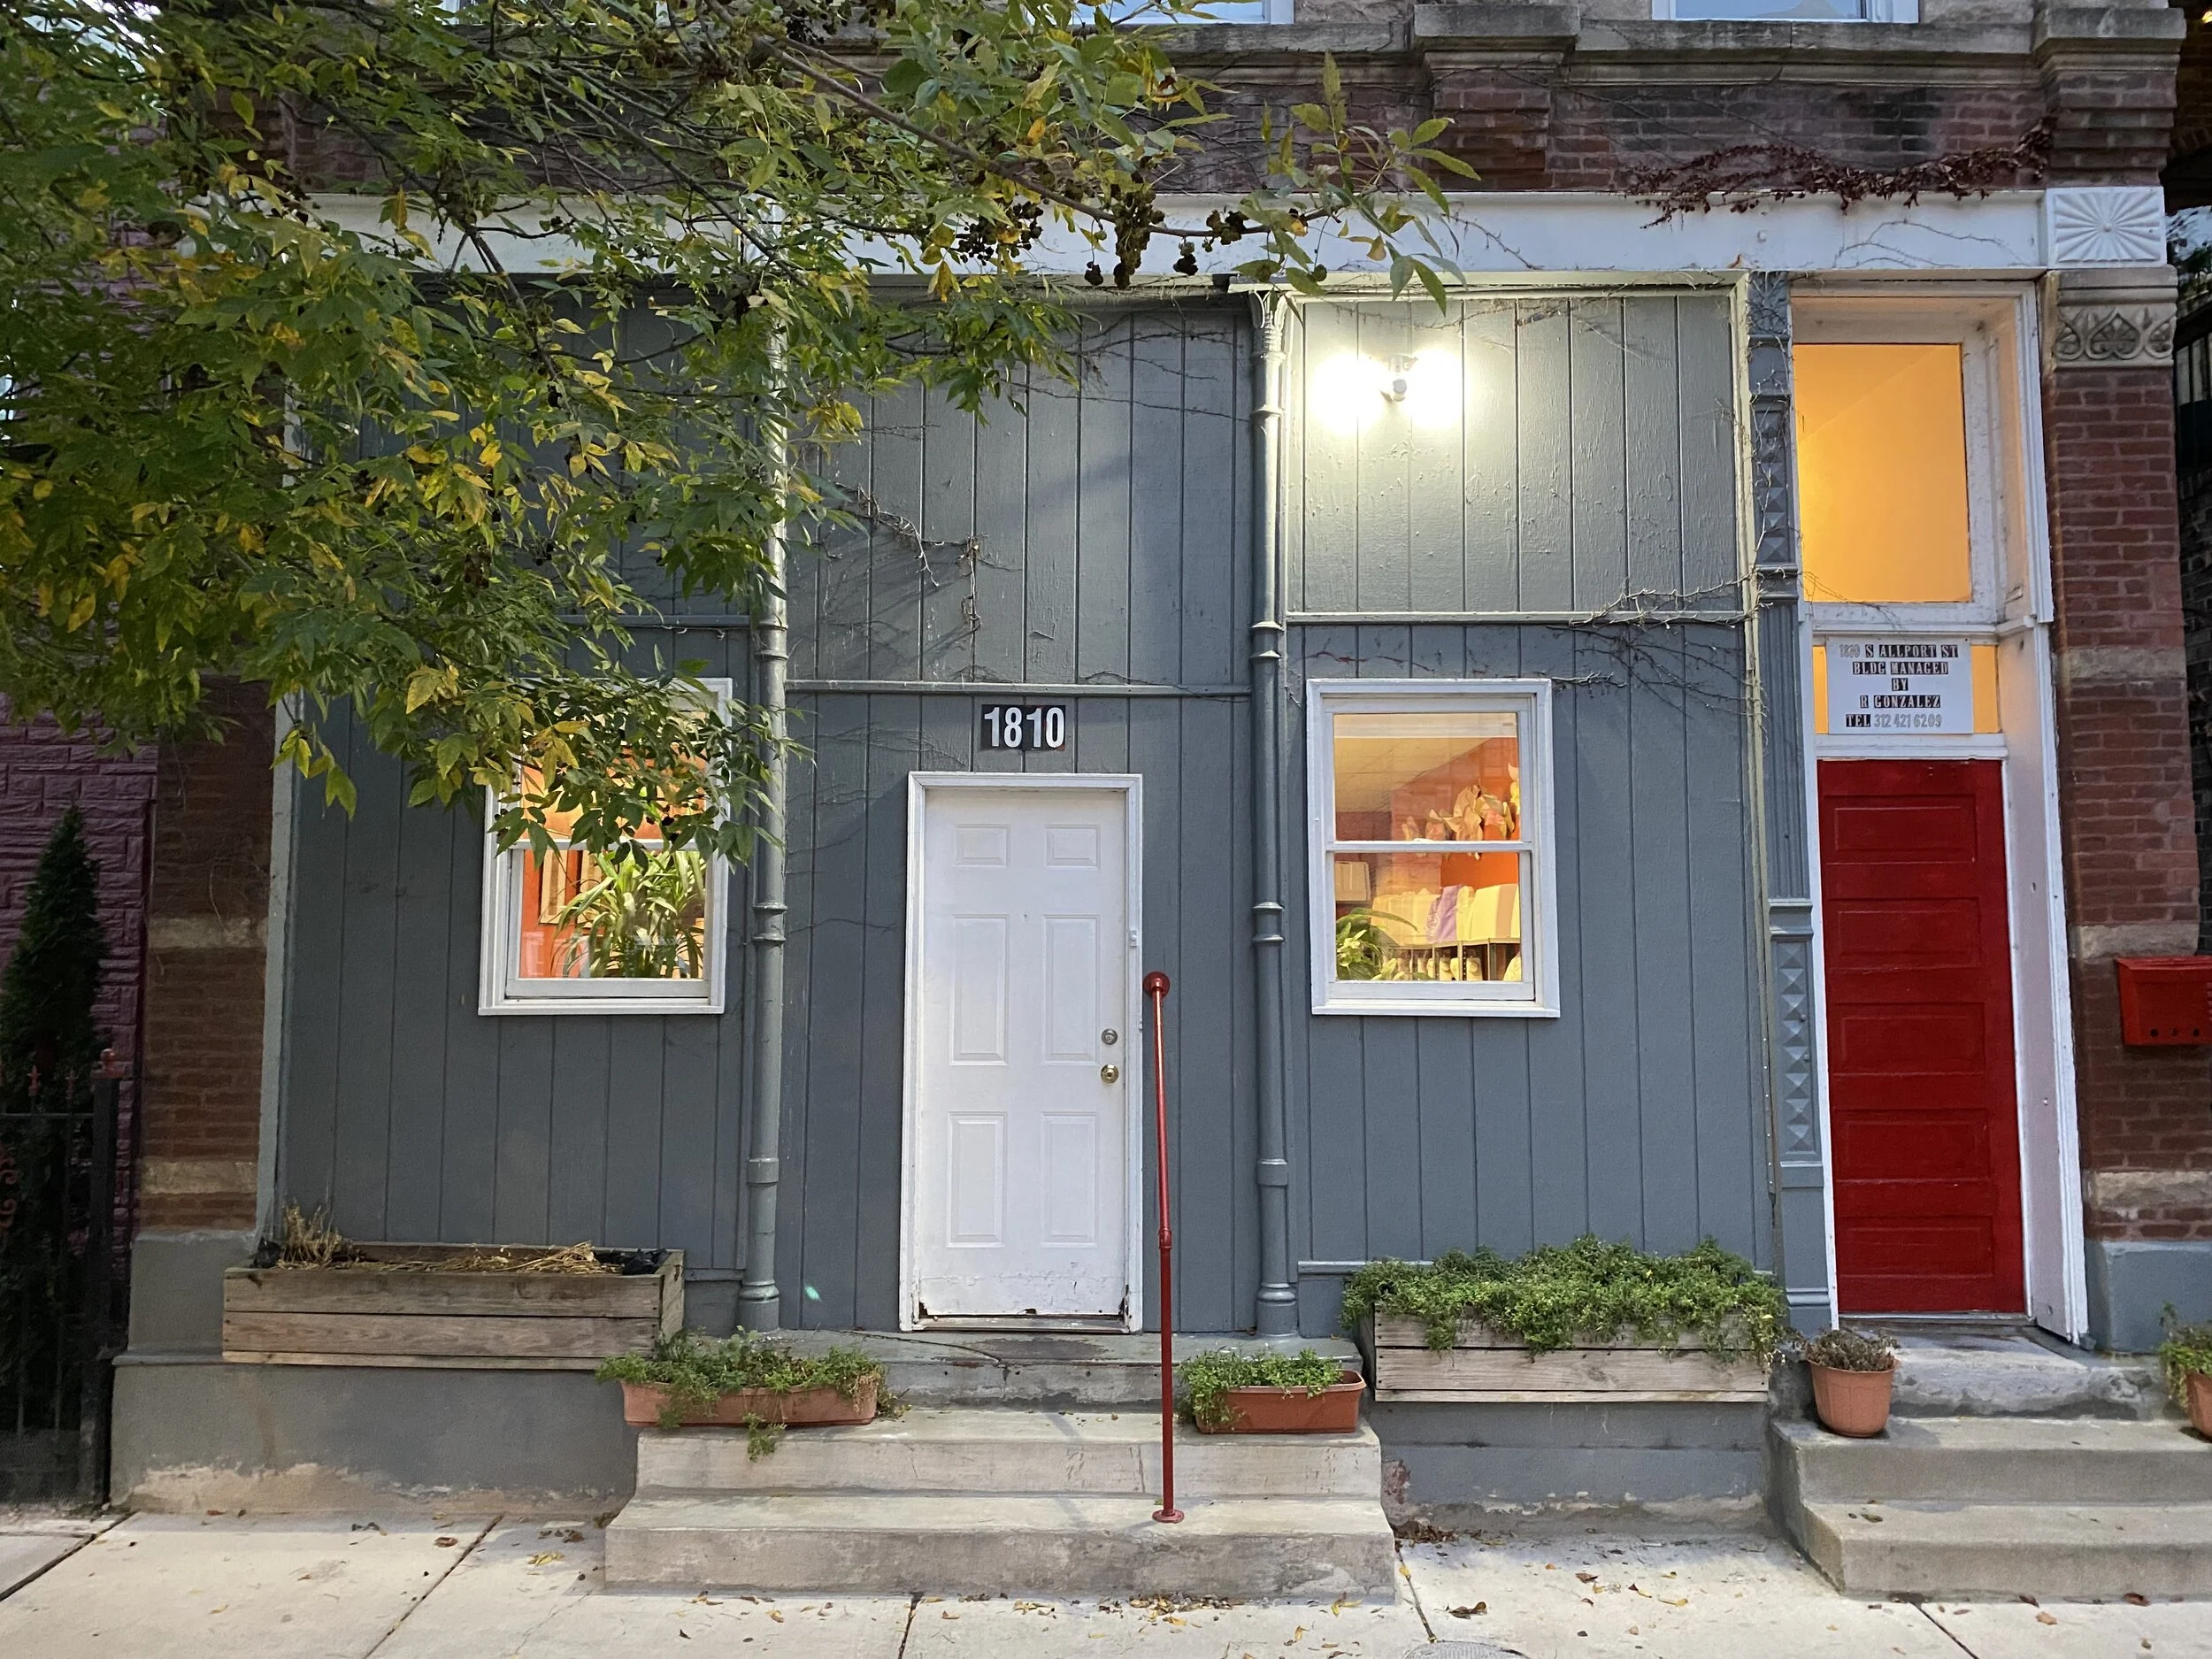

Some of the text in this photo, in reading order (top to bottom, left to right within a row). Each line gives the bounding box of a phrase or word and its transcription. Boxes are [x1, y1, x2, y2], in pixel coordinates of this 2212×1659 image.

[1865, 645, 1874, 657] S
[1879, 645, 1936, 657] ALLPORT
[1941, 645, 1958, 657] ST
[1853, 662, 1948, 674] BLDG MANAGED
[1892, 678, 1909, 691] BY
[1860, 695, 1940, 708] R GONZALEZ
[984, 706, 1064, 748] 1810
[1846, 714, 1870, 727] TEL
[1874, 714, 1891, 727] 312
[1894, 714, 1911, 727] 421
